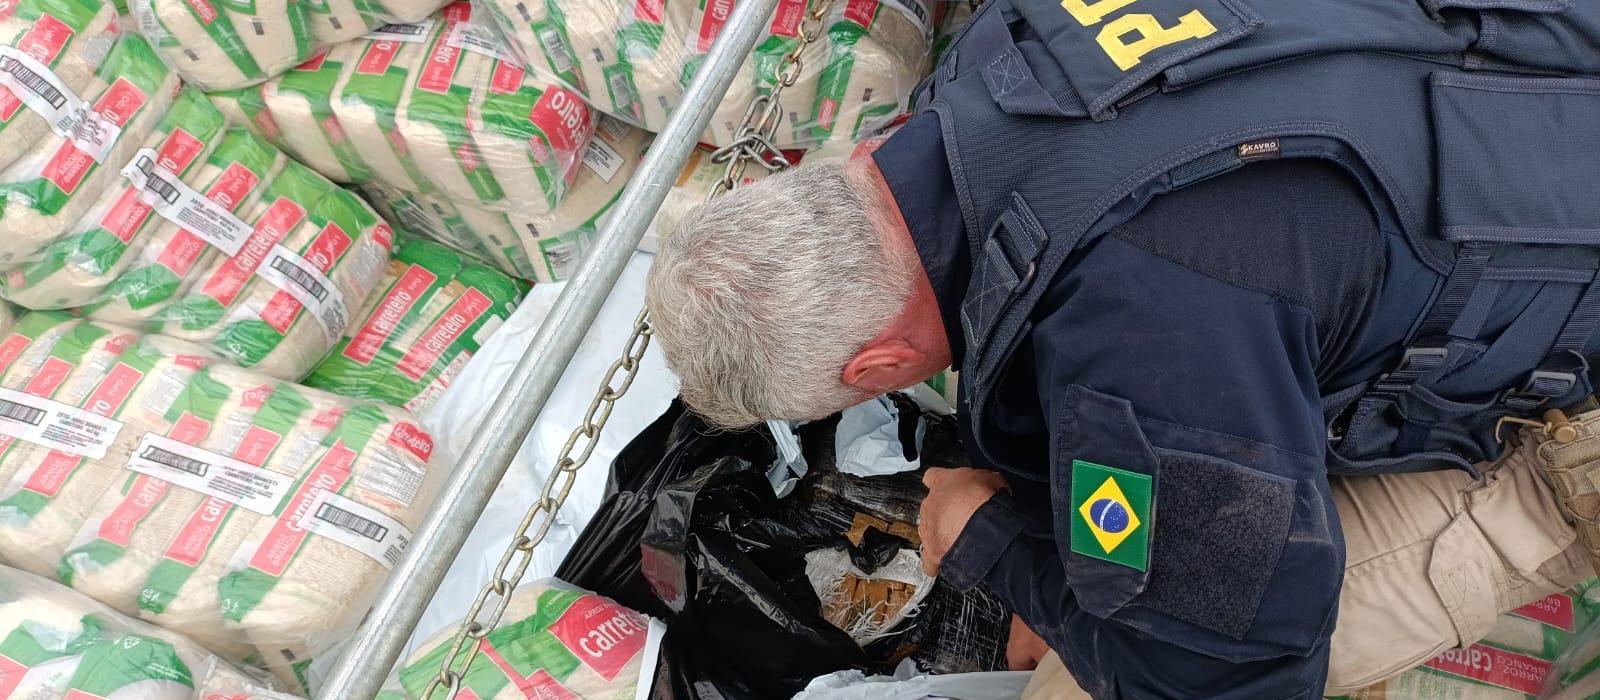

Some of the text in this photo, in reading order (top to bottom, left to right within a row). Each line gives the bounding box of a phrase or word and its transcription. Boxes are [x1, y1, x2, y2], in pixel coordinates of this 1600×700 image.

[1248, 142, 1276, 150] KAVRO
[374, 290, 412, 334] carreteiro
[424, 312, 467, 354] carreteiro
[393, 426, 431, 453] carreteiro
[134, 477, 166, 508] carre
[579, 610, 646, 658] carre
[1437, 648, 1492, 672] carre
[1496, 655, 1546, 676] BRANCO
